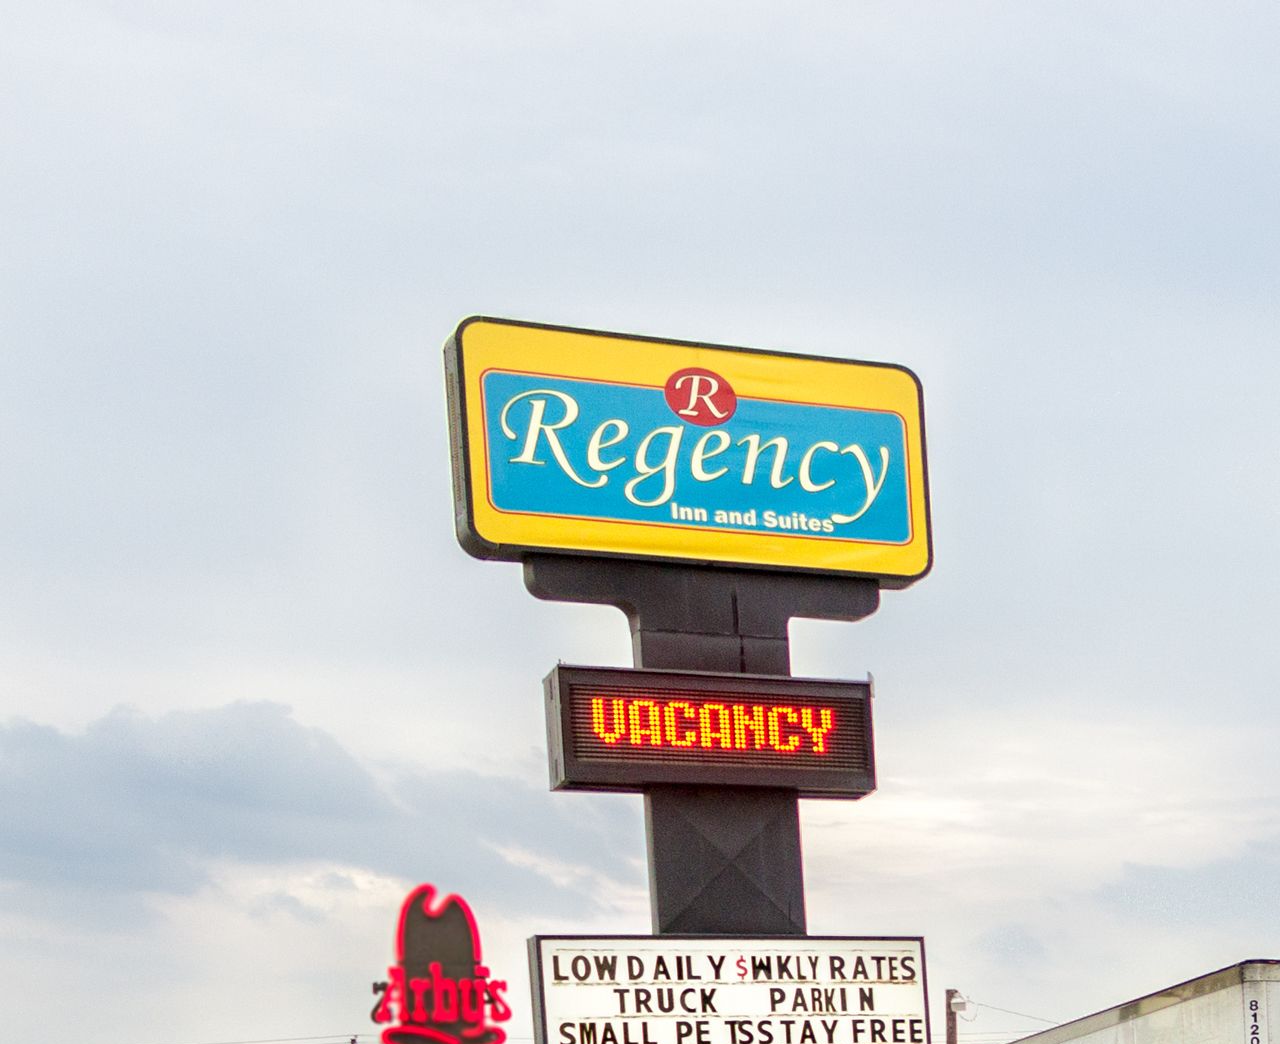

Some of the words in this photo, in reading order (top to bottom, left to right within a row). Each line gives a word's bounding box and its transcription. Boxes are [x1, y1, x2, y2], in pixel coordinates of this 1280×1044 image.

[675, 374, 729, 418] R
[500, 389, 890, 524] Regency
[672, 502, 707, 523] Inn
[714, 509, 757, 527] and
[763, 511, 834, 532] Suites
[591, 697, 836, 754] VACANCY
[552, 955, 618, 981] LOW
[628, 955, 726, 981] DAILY
[829, 955, 916, 981] RATES
[372, 961, 512, 1037] Arby's
[614, 988, 717, 1014] TRUCK
[852, 1018, 923, 1044] FREE
